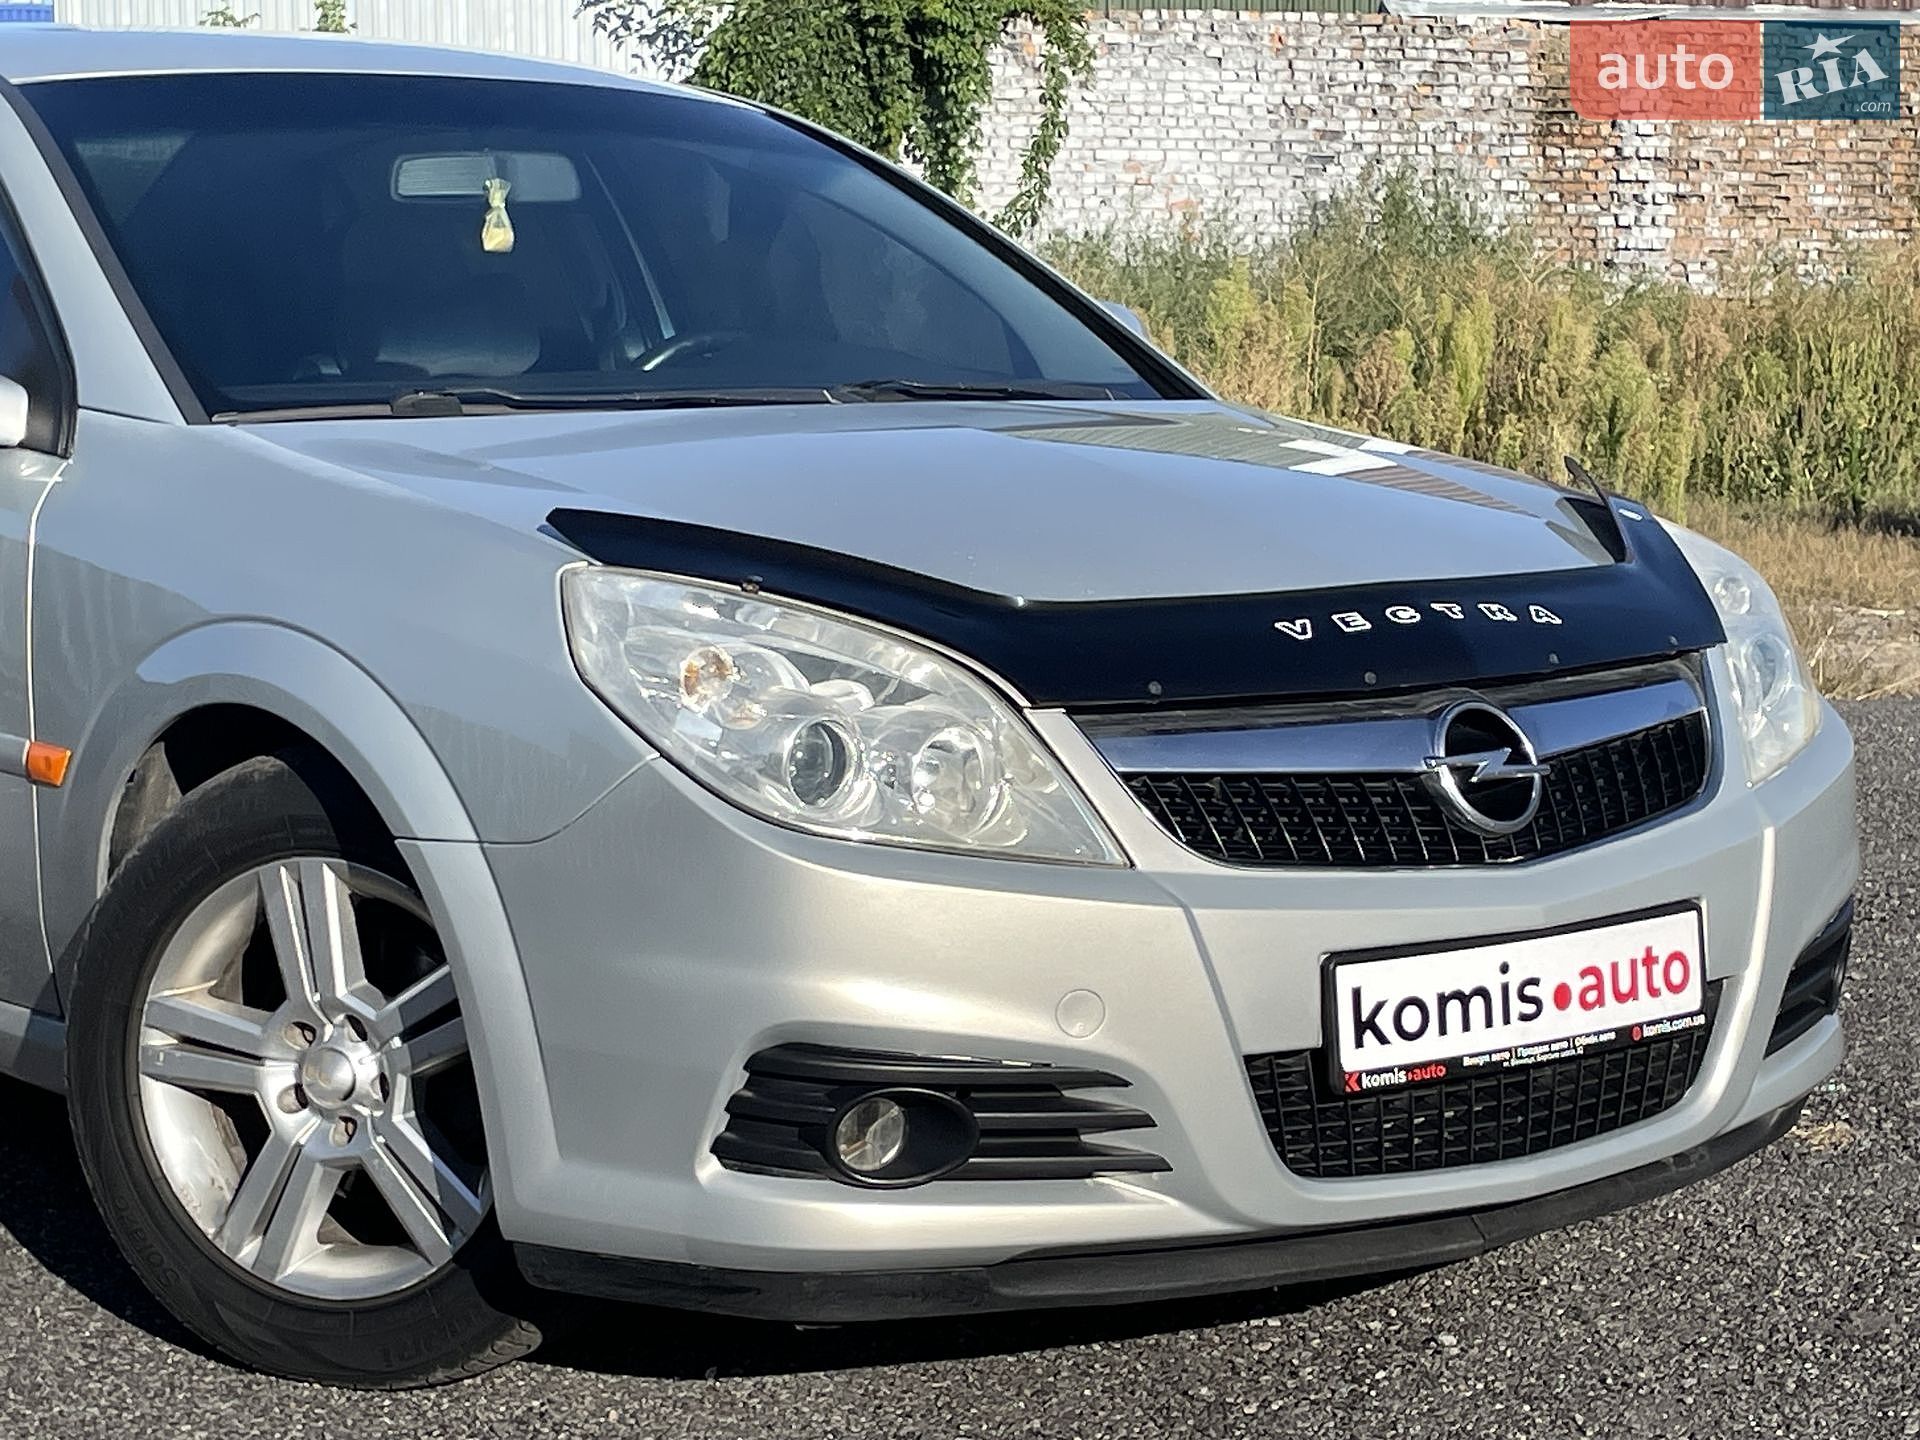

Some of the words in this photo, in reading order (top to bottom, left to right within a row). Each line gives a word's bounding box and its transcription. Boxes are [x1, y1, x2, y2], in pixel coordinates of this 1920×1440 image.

[1274, 602, 1563, 640] VECTRA
[1352, 961, 1545, 1049] komis
[1579, 946, 1690, 1011] auto
